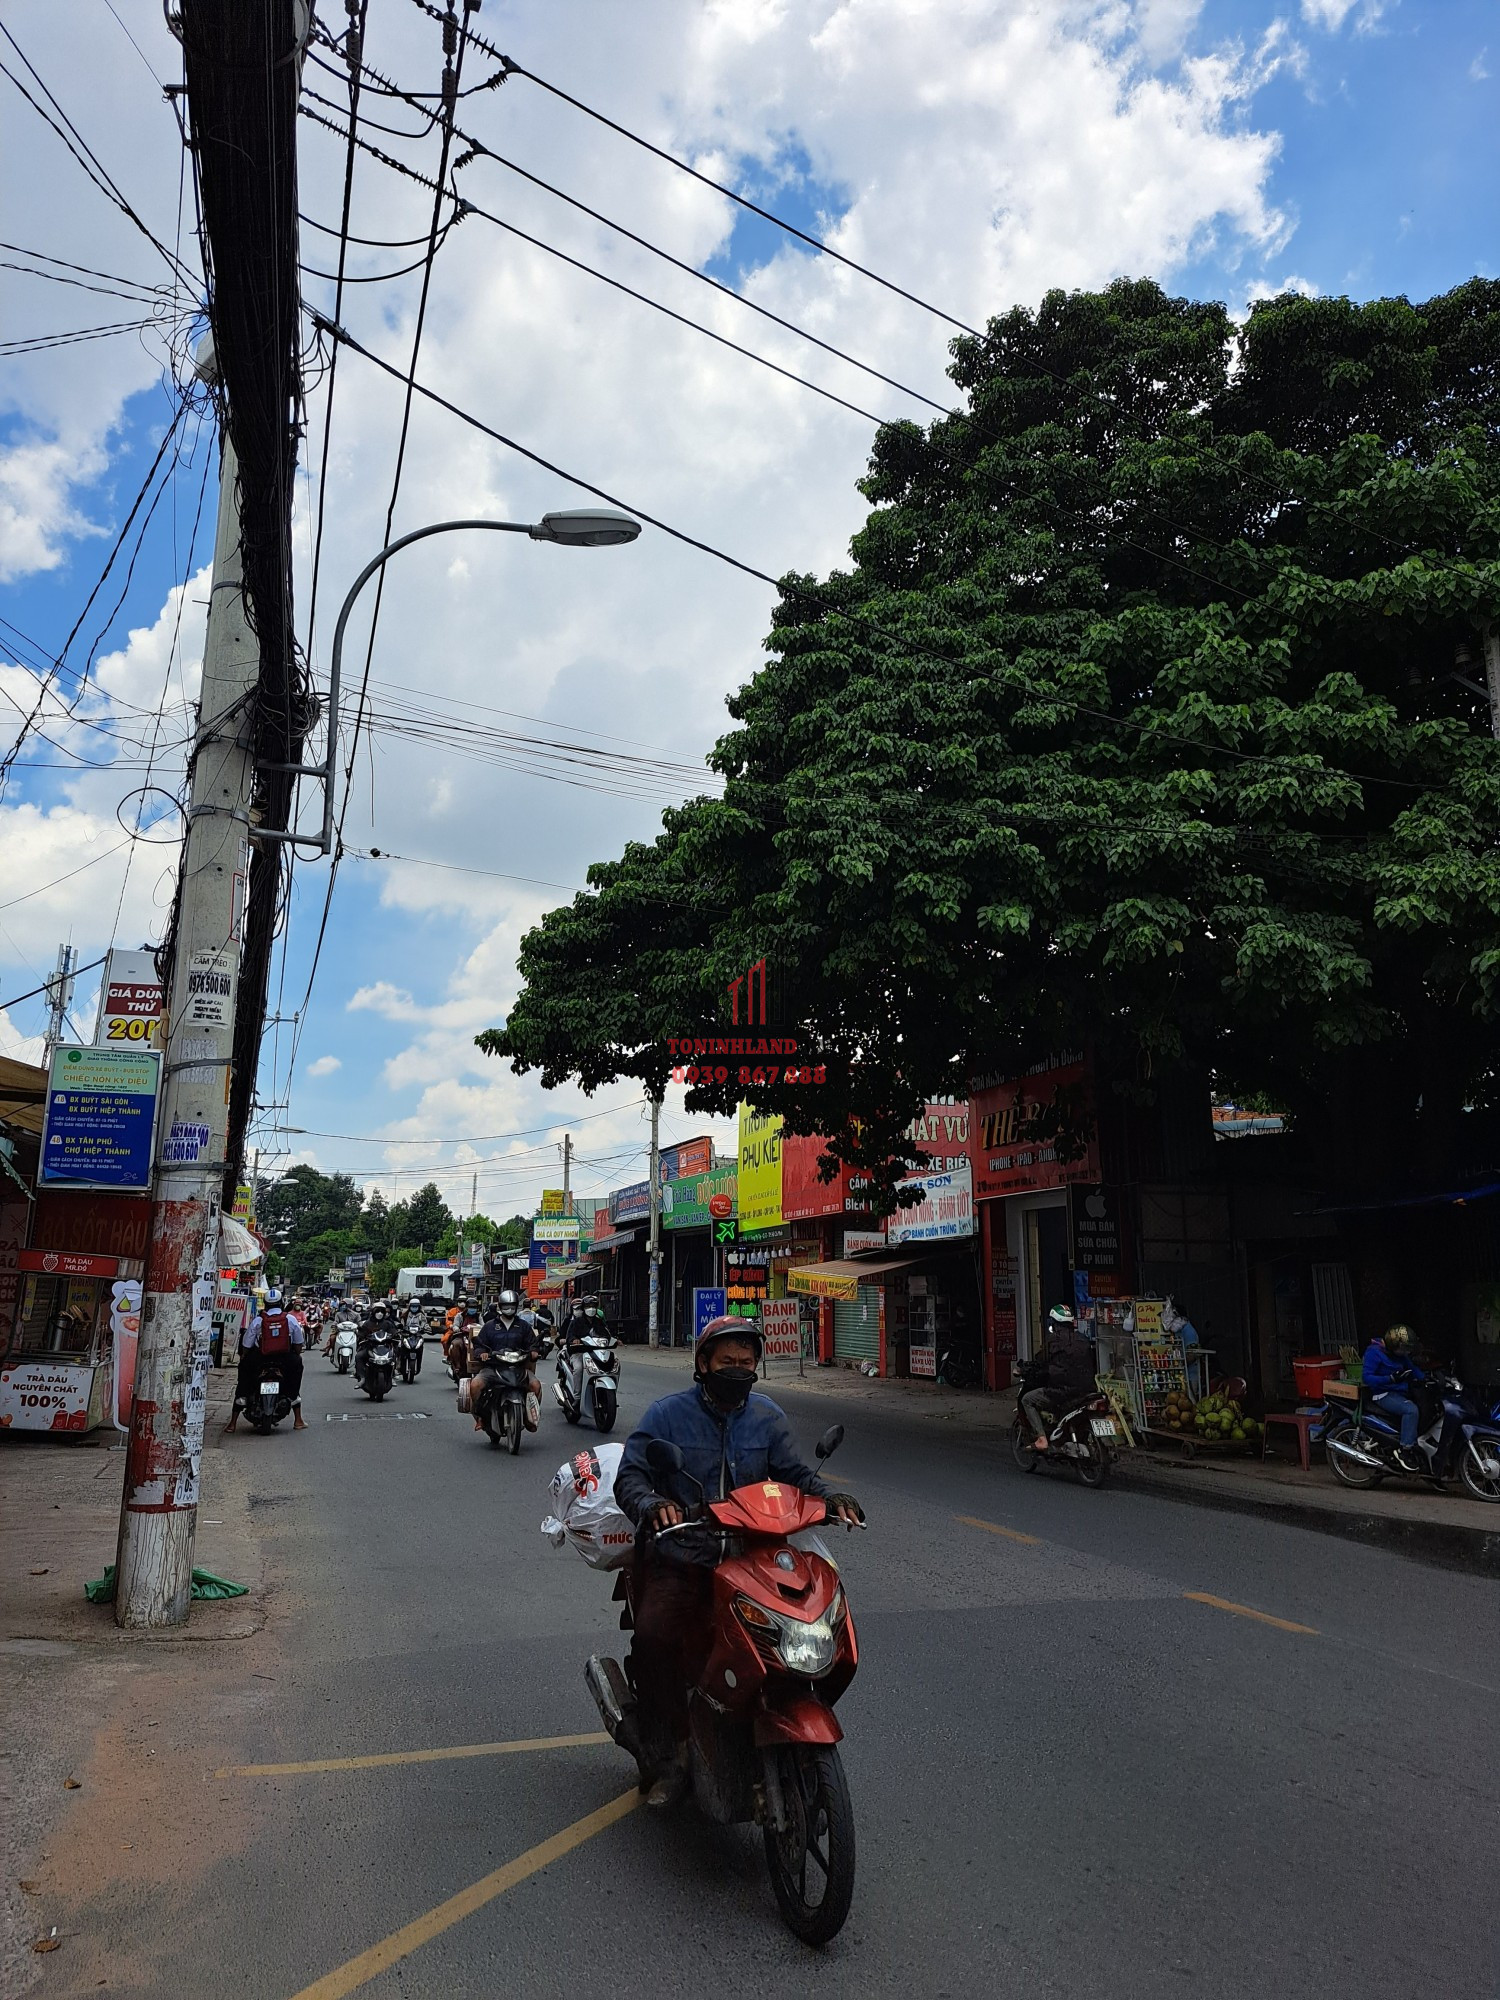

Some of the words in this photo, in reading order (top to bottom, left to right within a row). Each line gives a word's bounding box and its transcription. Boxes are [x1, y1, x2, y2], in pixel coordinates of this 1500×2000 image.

[109, 986, 131, 999] GIÁ
[127, 1001, 156, 1013] THỬ
[63, 1073, 90, 1083] CHIẾC
[92, 1076, 111, 1084] NÓN
[81, 1096, 98, 1105] BUÝT
[100, 1096, 112, 1105] SÀI
[114, 1096, 129, 1105] GÒN
[80, 1105, 97, 1114] BUÝT
[100, 1107, 116, 1115] HIỆP
[118, 1107, 141, 1115] THÀNH
[52, 1136, 61, 1144] 48
[65, 1137, 75, 1145] BX
[79, 1137, 94, 1145] TÂN
[96, 1136, 112, 1145] PHÚ
[64, 1146, 80, 1154] CHỢ
[83, 1147, 101, 1156] HIỆP
[104, 1147, 130, 1156] THÀNH
[743, 1142, 761, 1174] PHỤ
[989, 1155, 1012, 1171] IPHONE
[1017, 1152, 1033, 1167] IPAD
[927, 1174, 953, 1189] SƠN
[938, 1190, 956, 1221] BÁNH
[1080, 1220, 1096, 1232] MUA
[1099, 1219, 1115, 1232] BÁN
[911, 1227, 925, 1240] BÁNH
[700, 1292, 712, 1300] ĐẠI
[227, 1298, 245, 1311] KHOA
[705, 1302, 717, 1312] VÉ
[763, 1302, 797, 1317] BÁNH
[764, 1319, 798, 1336] CUỐN
[765, 1336, 799, 1355] NÓNG
[27, 1374, 46, 1383] TRÀ
[48, 1375, 68, 1384] DÂU
[13, 1382, 55, 1393] NGUYÊN
[57, 1383, 79, 1395] CHẤT
[20, 1394, 66, 1409] 100%
[602, 1532, 633, 1545] THỨC
